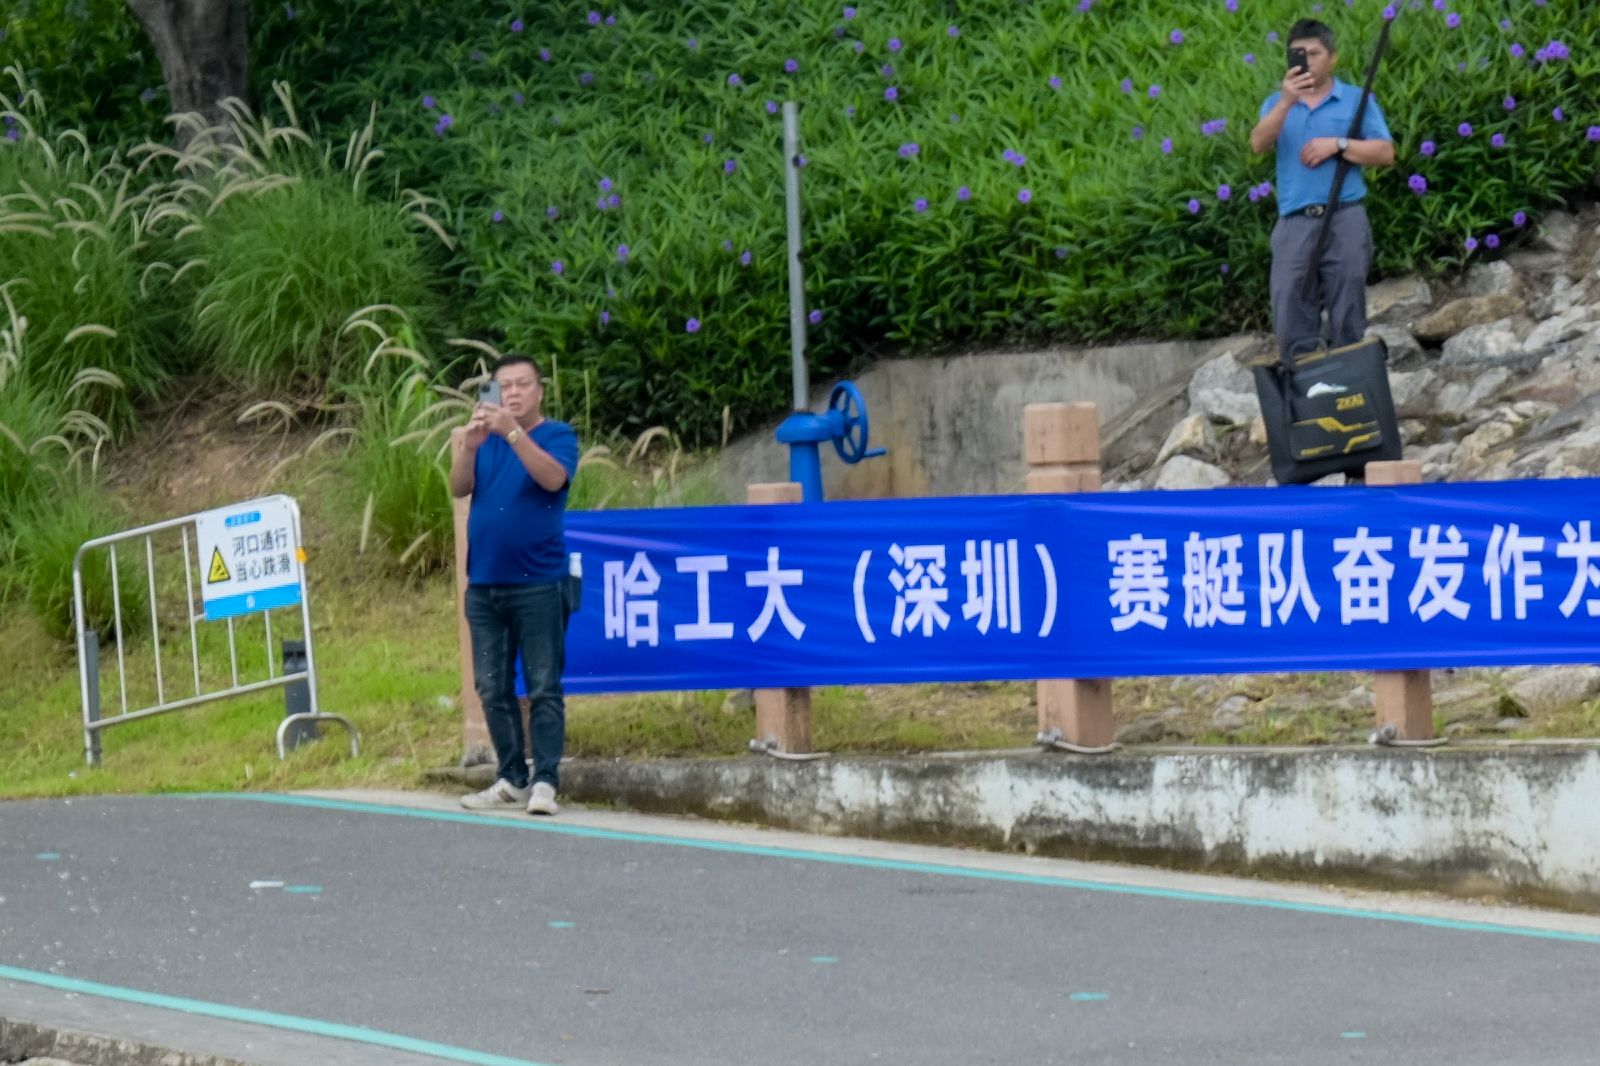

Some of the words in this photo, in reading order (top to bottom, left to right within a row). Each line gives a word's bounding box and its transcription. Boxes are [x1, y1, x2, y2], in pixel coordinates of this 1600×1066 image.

[232, 527, 288, 557] 河口通行
[236, 553, 291, 582] 当心跌滑
